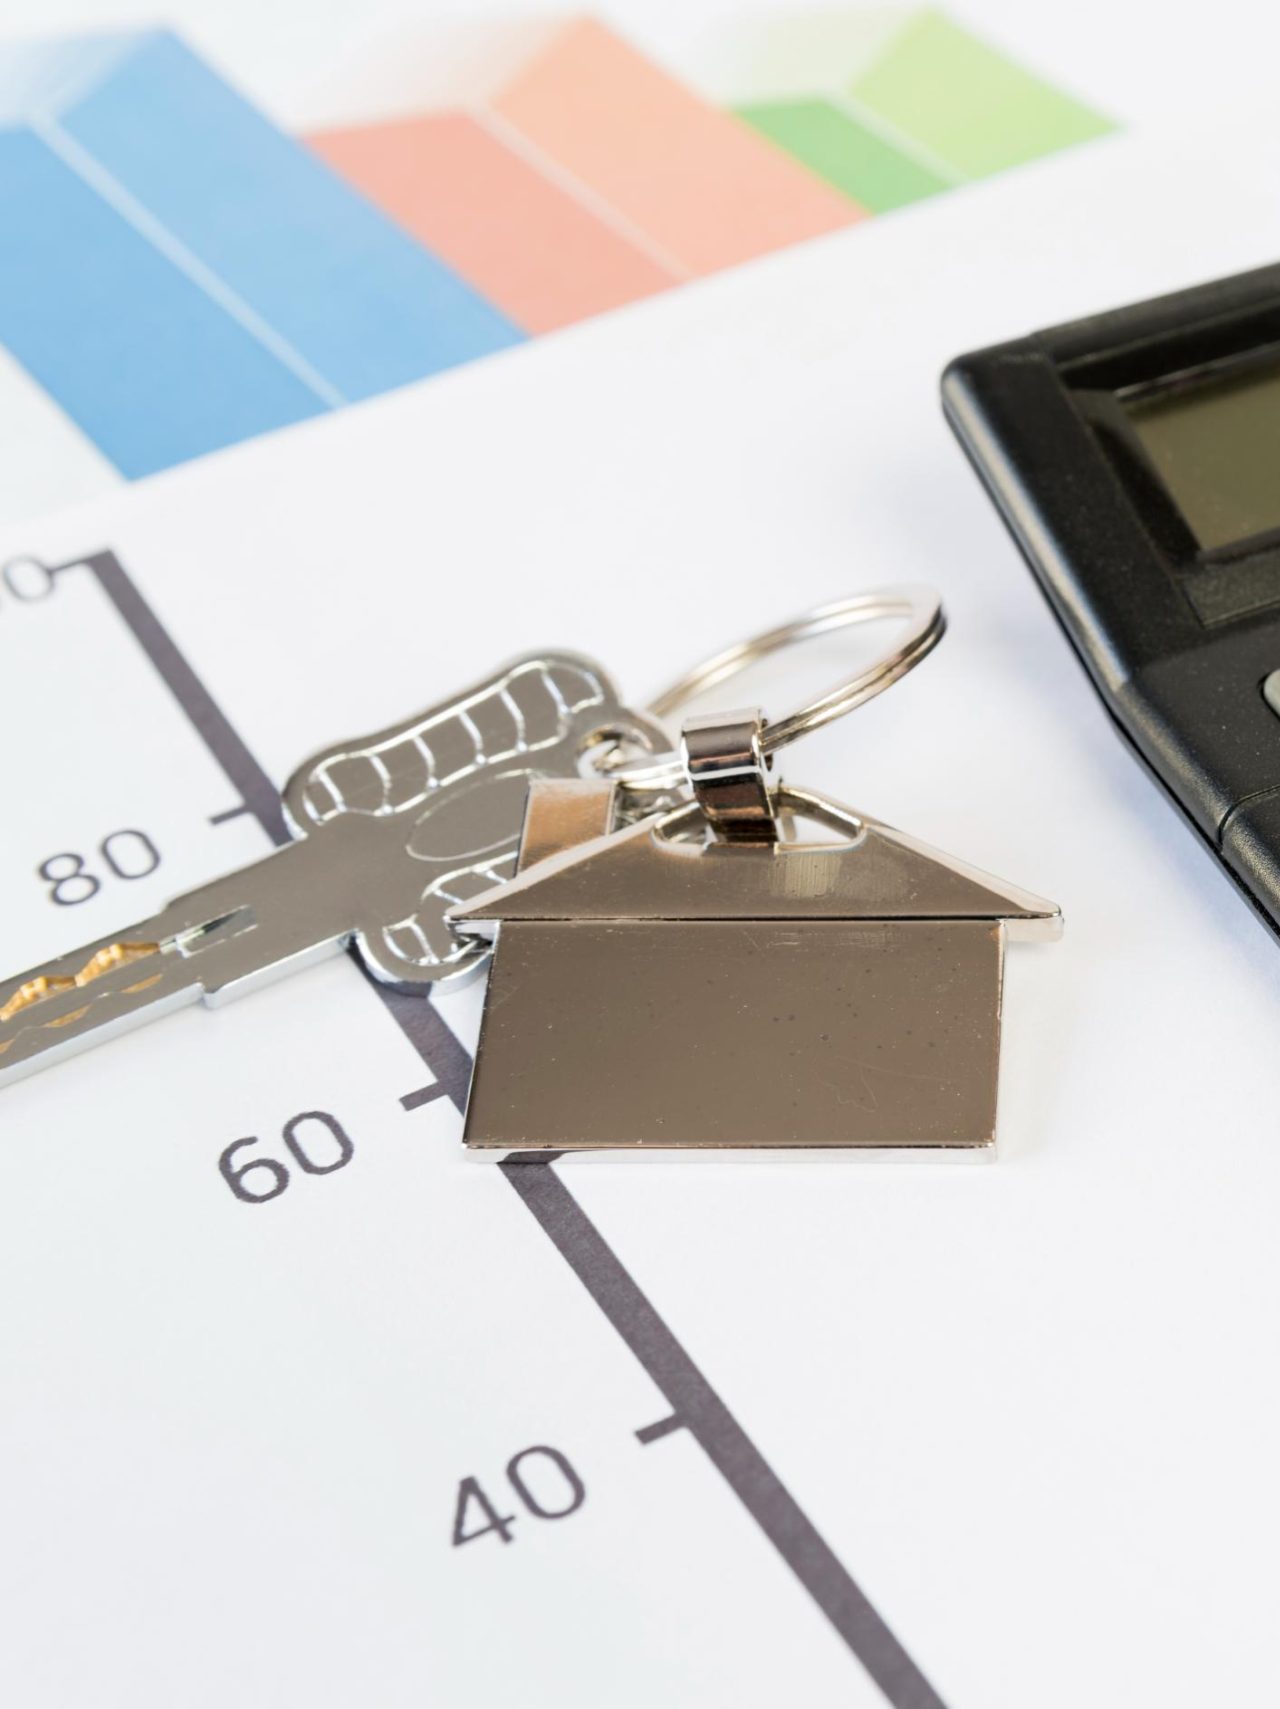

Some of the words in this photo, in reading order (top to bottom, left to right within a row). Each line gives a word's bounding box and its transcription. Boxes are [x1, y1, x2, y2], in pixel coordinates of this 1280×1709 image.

[37, 828, 162, 908] 80
[218, 1109, 355, 1204] 60
[451, 1444, 586, 1548] 40
